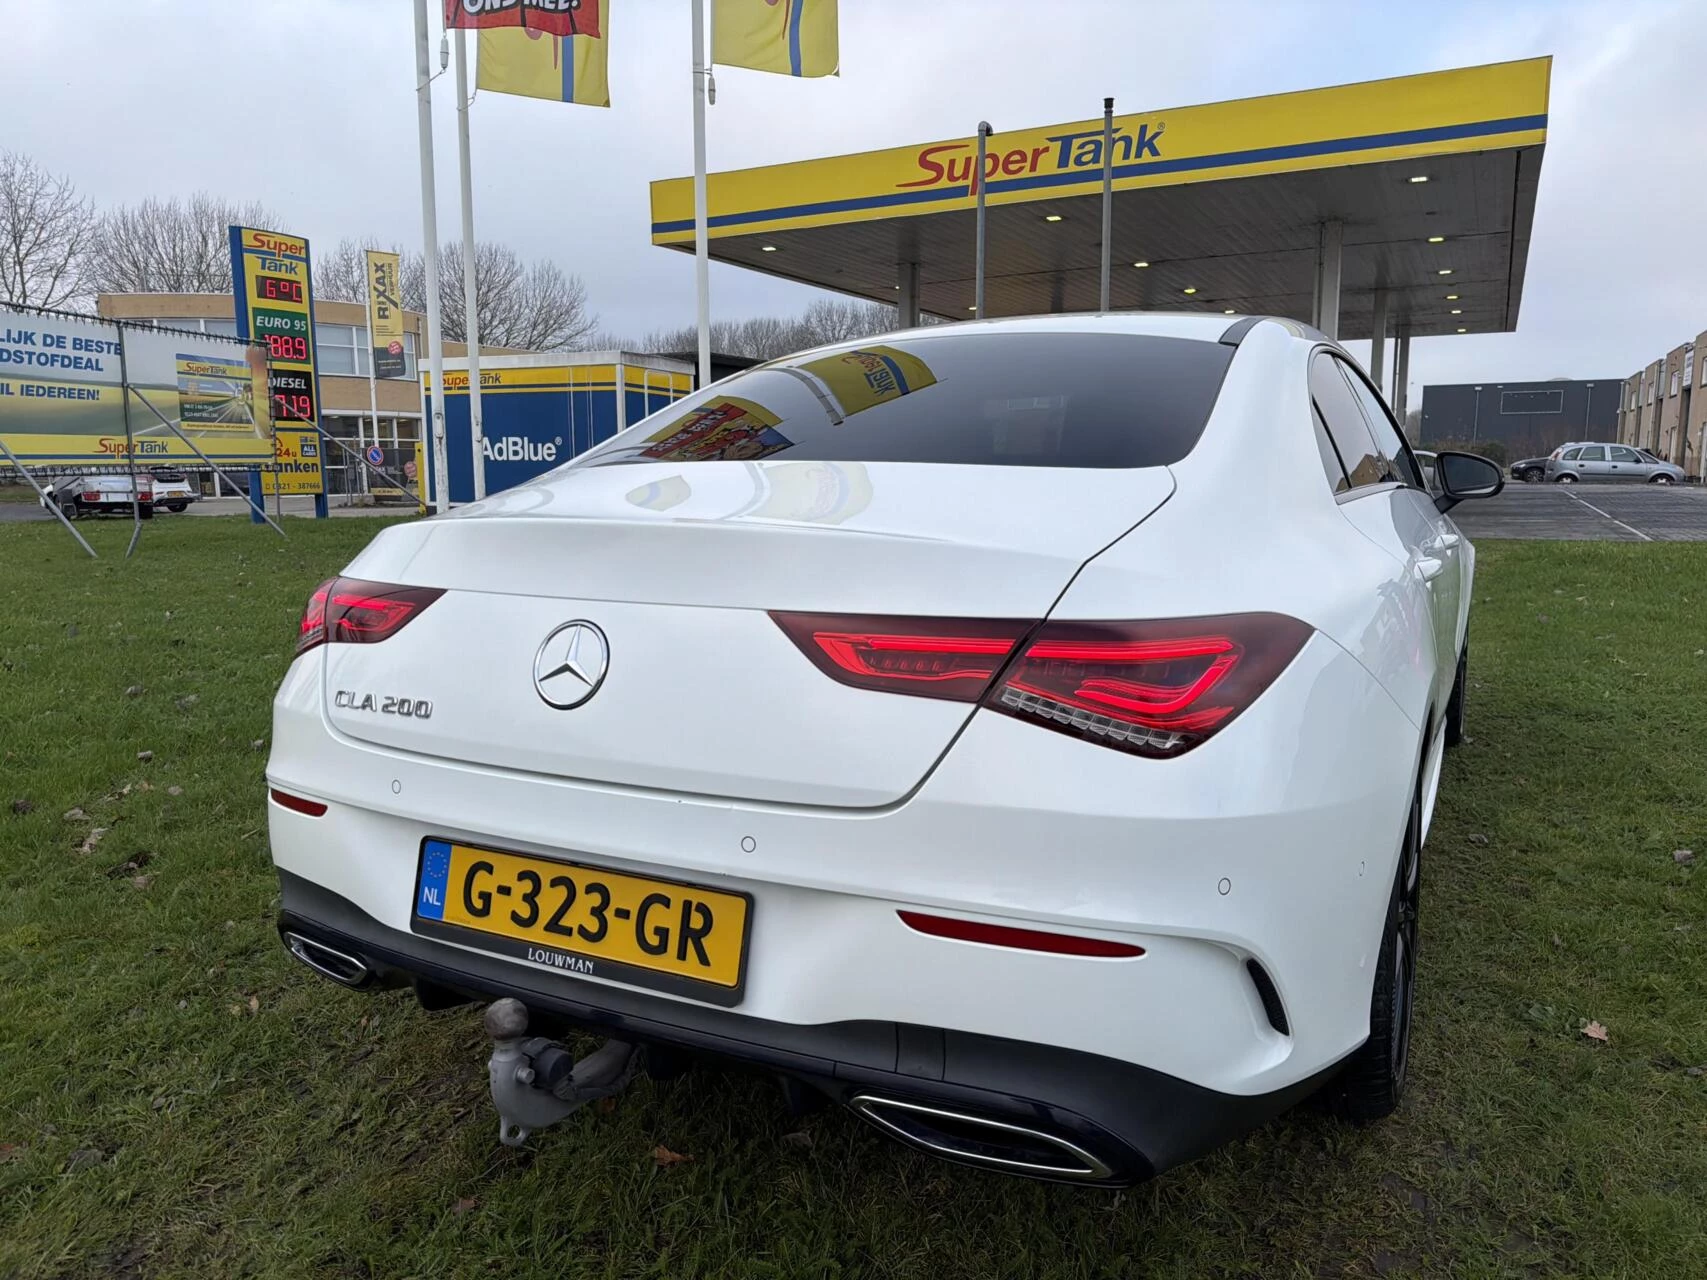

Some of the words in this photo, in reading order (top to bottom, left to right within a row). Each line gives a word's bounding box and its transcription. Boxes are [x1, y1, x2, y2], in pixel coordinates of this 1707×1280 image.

[243, 233, 305, 258] Super
[255, 256, 299, 275] Tank
[256, 316, 291, 329] EURO
[294, 320, 307, 331] 95
[0, 328, 37, 346] IJK
[42, 333, 67, 350] DE
[72, 337, 122, 356] BESTE
[20, 384, 100, 401] IEDEREEN!
[268, 377, 307, 389] DIESEL
[264, 459, 319, 473] nken
[335, 690, 377, 713] CLA
[381, 696, 433, 719] 200
[423, 886, 441, 906] NL
[463, 861, 713, 967] G-323-GR
[528, 948, 594, 974] LOUWMAN
